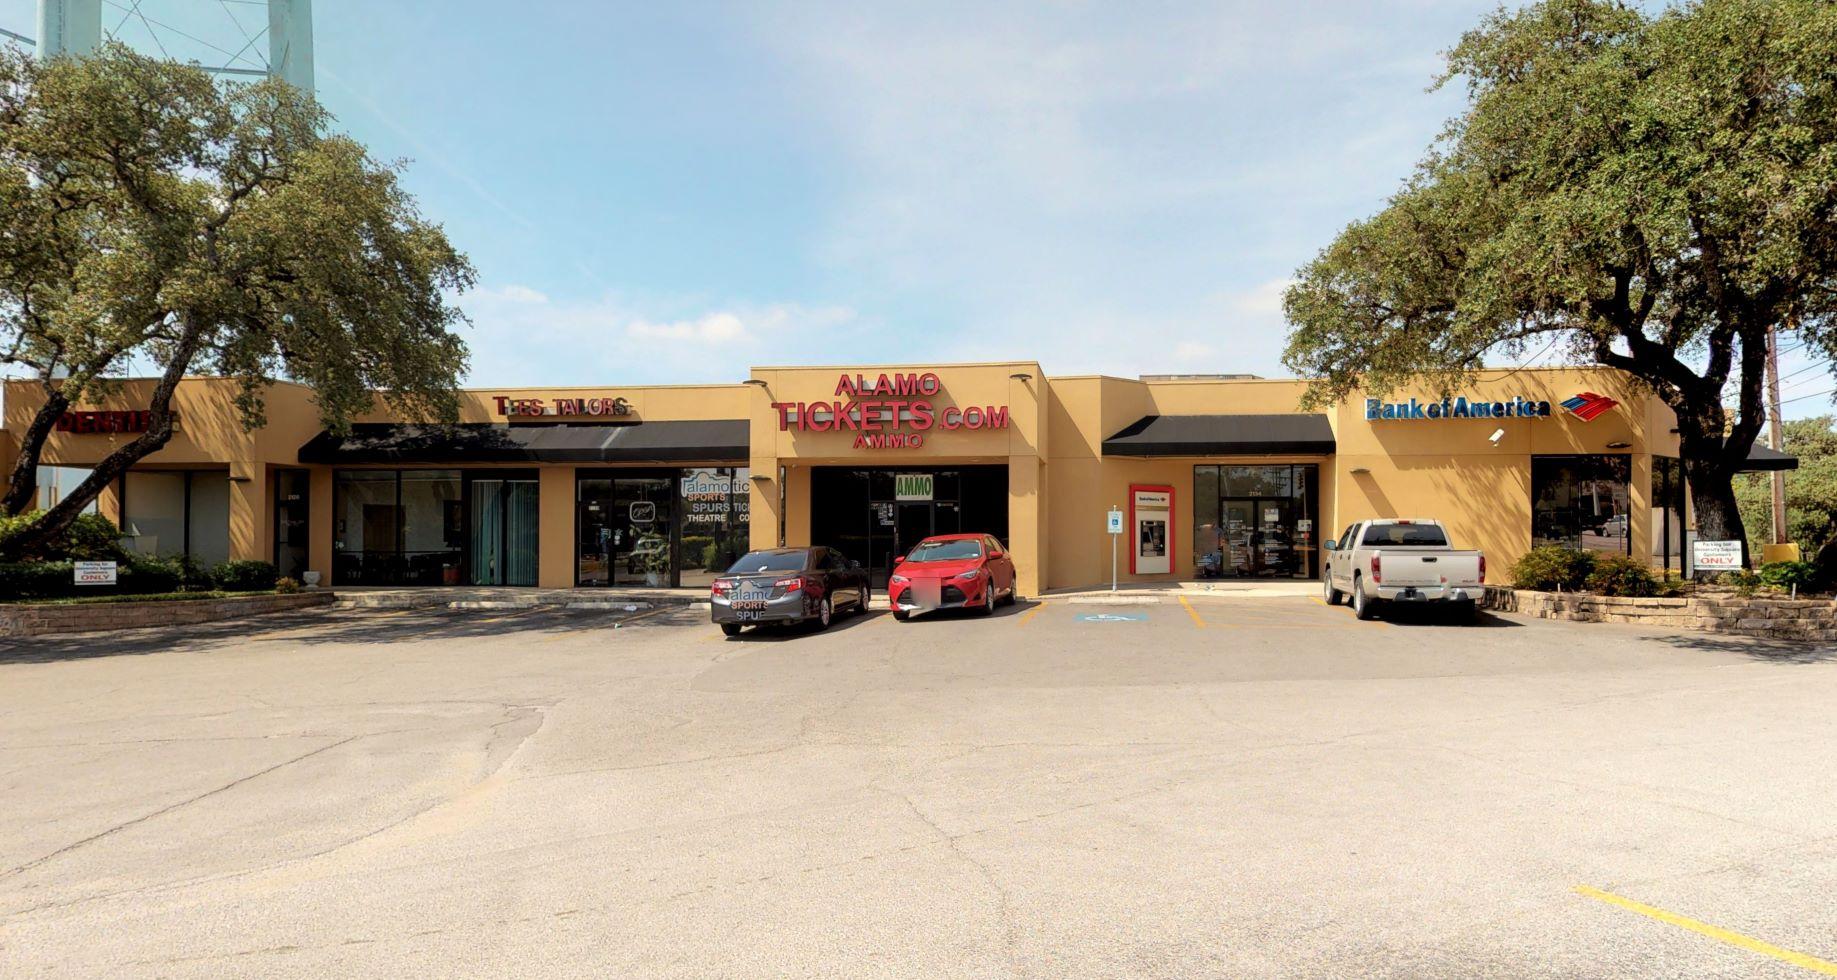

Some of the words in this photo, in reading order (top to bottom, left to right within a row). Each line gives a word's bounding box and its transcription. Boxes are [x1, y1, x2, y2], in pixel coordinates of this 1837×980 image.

[834, 373, 941, 396] ALAMO
[1365, 397, 1425, 420] Bank
[1426, 398, 1451, 420] of
[1452, 396, 1551, 420] America
[853, 433, 924, 449] AMMO
[687, 480, 729, 492] alamo
[896, 477, 932, 496] AMMO
[687, 493, 726, 501] SPORTS
[692, 503, 731, 513] SPURS
[687, 514, 727, 522] THEATRE
[731, 601, 769, 609] SPORTS
